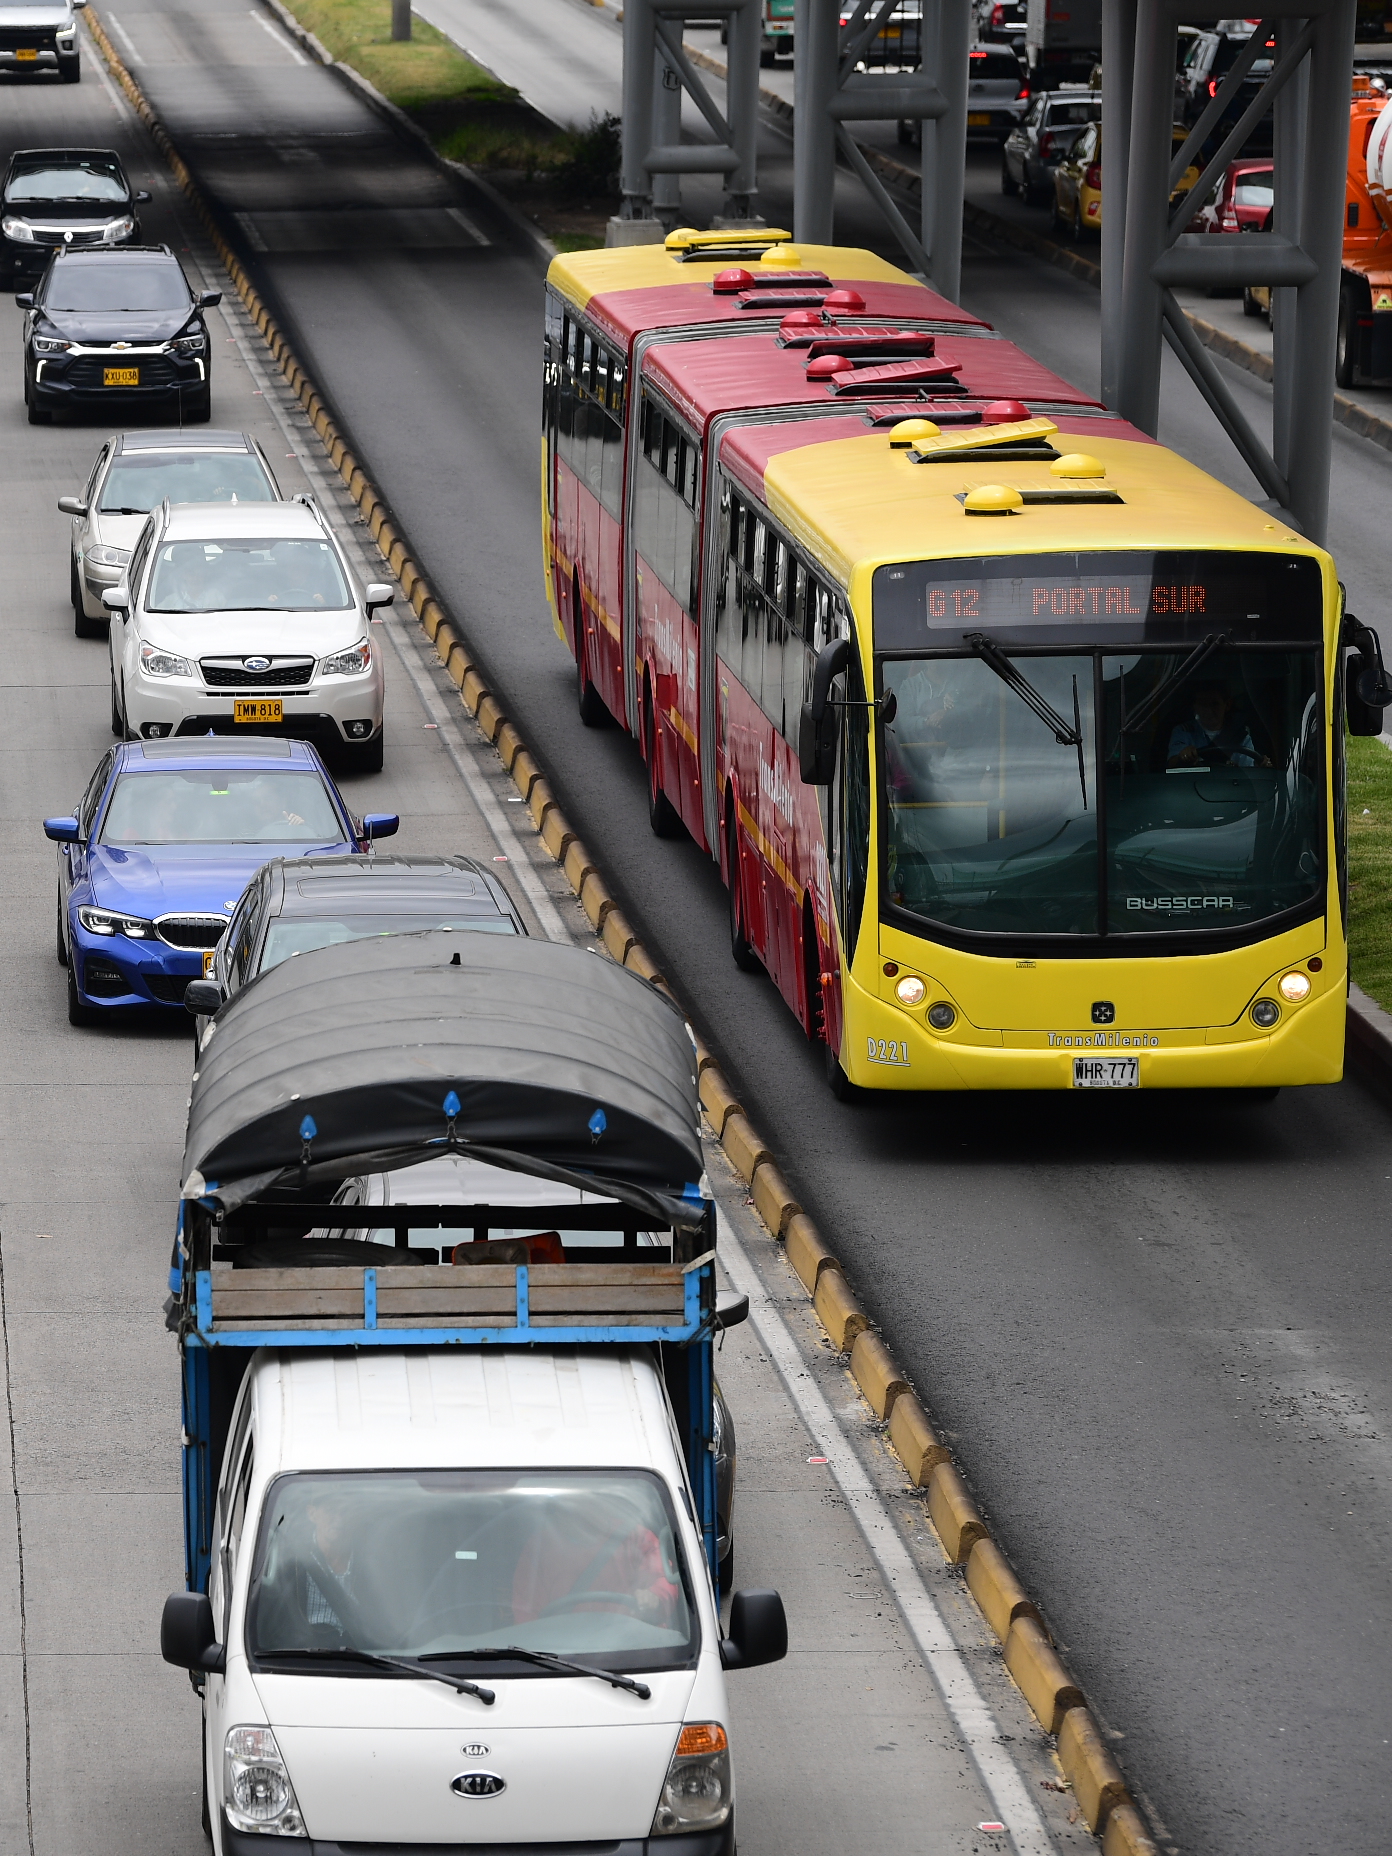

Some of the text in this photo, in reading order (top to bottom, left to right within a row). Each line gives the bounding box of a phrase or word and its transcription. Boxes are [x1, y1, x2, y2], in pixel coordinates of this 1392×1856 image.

[929, 585, 1206, 617] G12 PORTAL SUR
[1126, 896, 1234, 910] BUSSCAR
[1048, 1032, 1159, 1047] TransMilenio
[867, 1036, 909, 1062] D221
[465, 1745, 487, 1755] KIA
[459, 1777, 498, 1793] KIA
